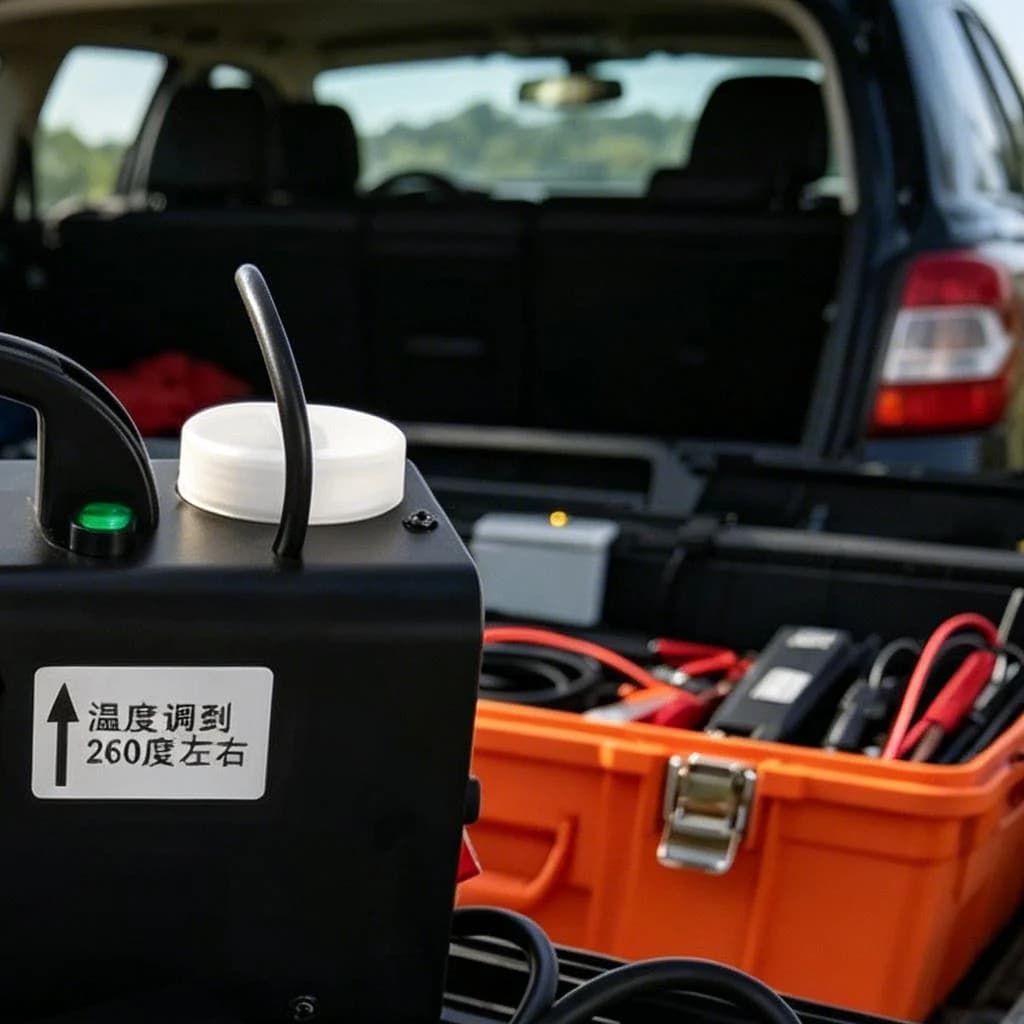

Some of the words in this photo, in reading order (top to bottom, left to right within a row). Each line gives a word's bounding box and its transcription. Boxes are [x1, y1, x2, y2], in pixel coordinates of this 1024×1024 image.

[88, 702, 232, 733] 温度调到
[86, 734, 249, 767] 260度左右
